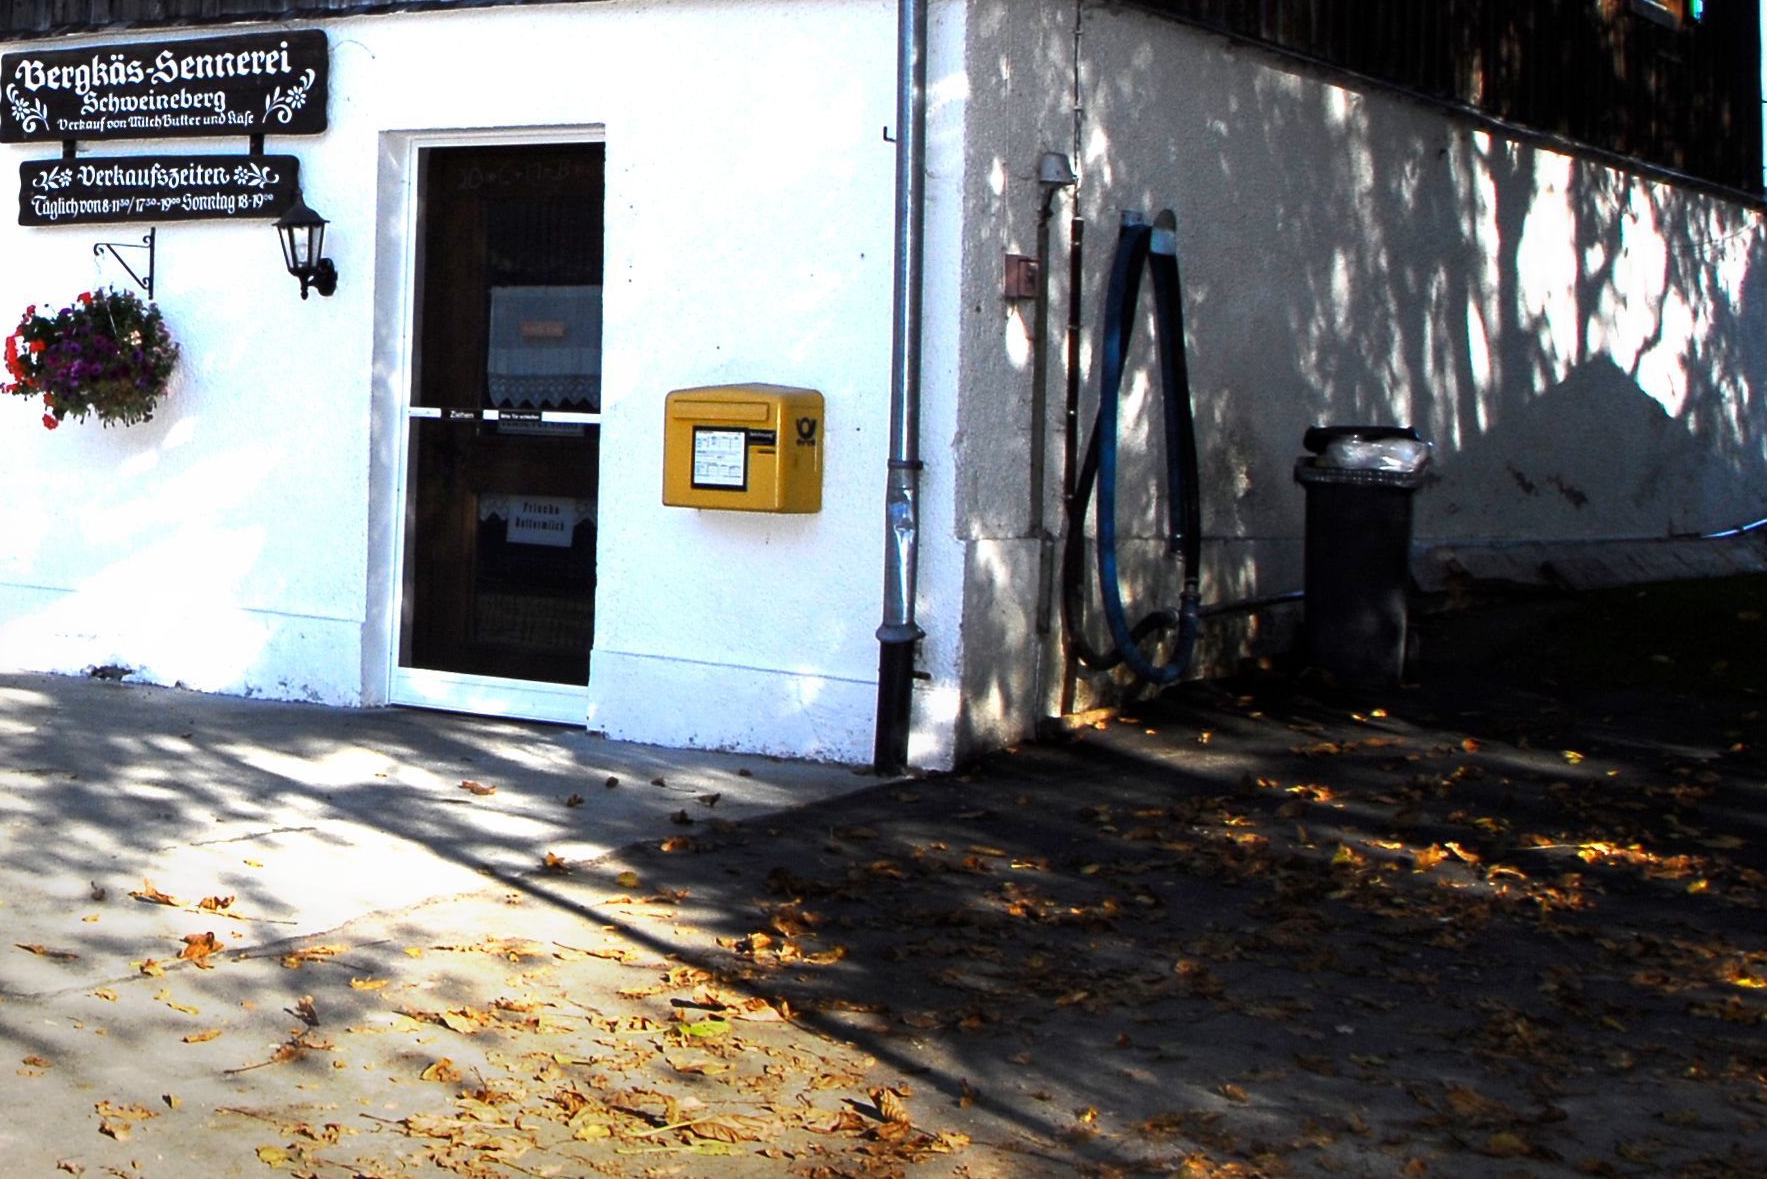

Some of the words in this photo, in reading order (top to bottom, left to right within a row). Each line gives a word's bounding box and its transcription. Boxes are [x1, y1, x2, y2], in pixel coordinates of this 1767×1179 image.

[15, 41, 292, 95] Bergkäs-Sennerei
[81, 88, 226, 115] Schweineberg
[57, 117, 106, 132] Verkauf
[107, 120, 127, 129] von
[203, 112, 226, 127] und
[77, 162, 230, 188] Verkaufszeiten
[181, 192, 235, 214] Sonntag
